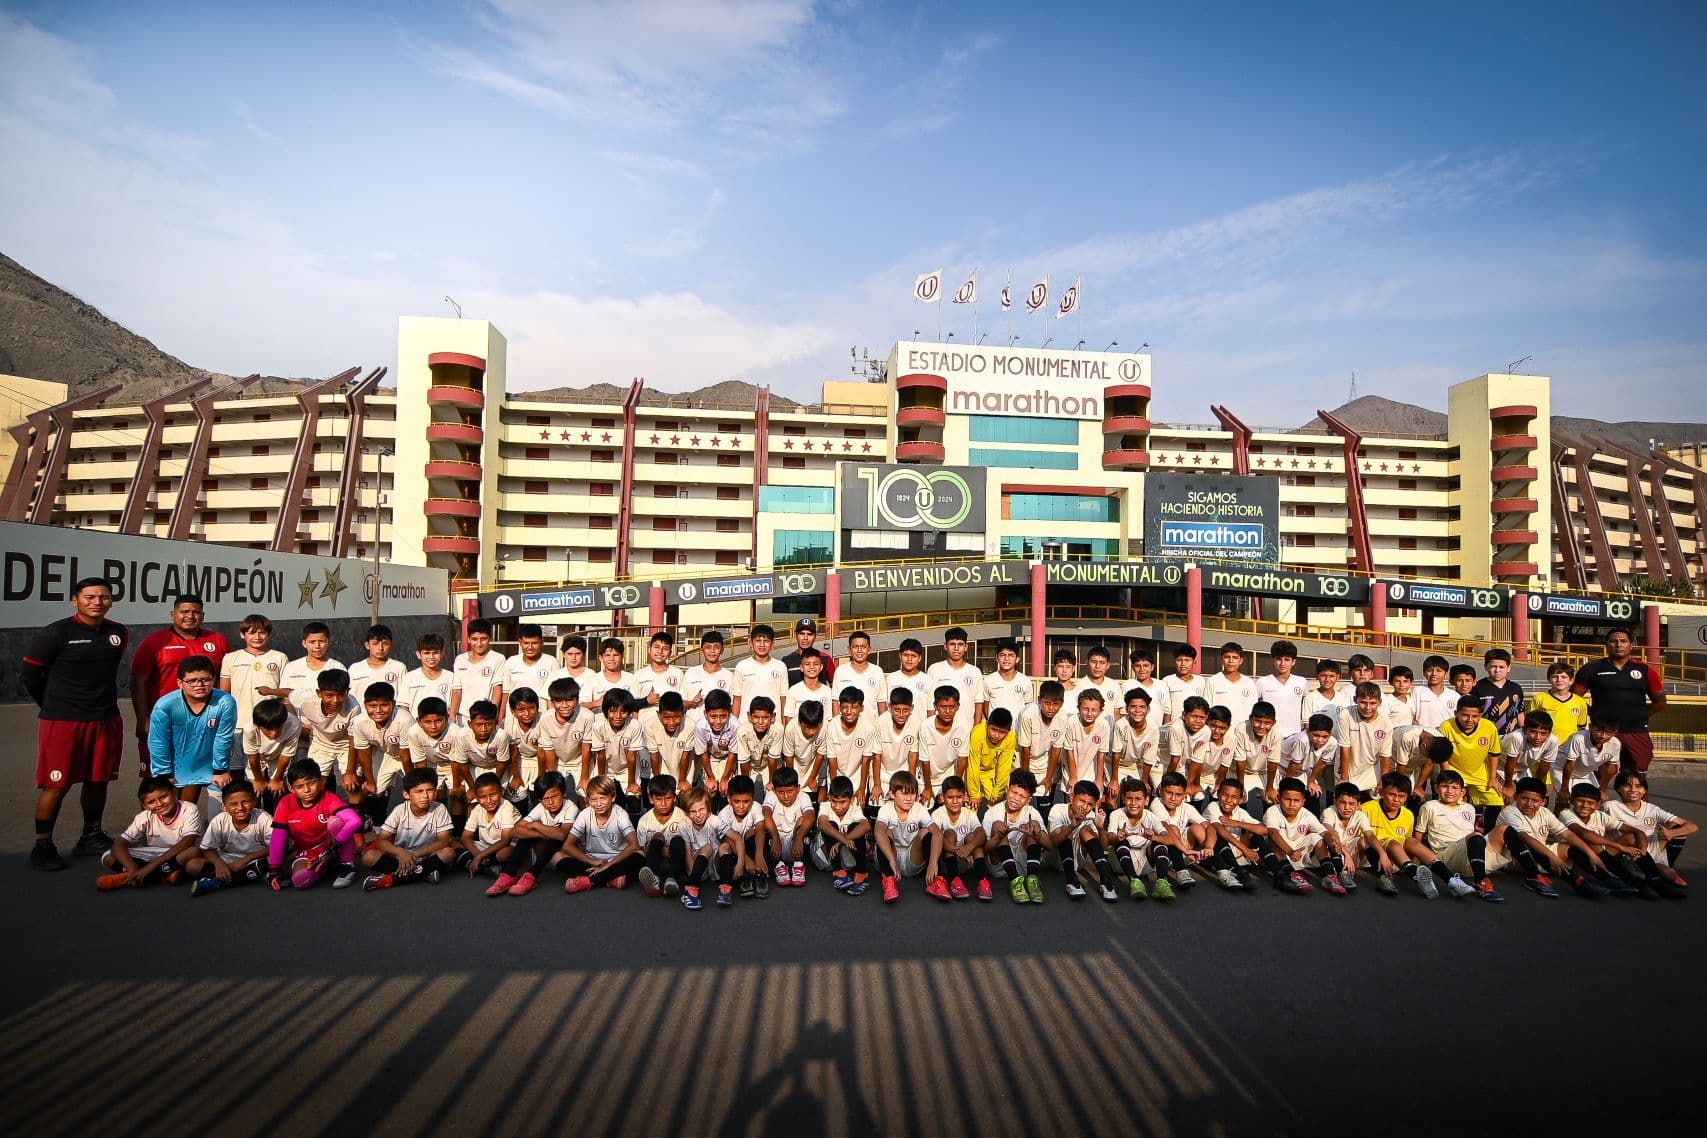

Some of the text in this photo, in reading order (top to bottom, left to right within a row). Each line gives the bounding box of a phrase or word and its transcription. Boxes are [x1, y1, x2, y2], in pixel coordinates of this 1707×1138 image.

[909, 351, 1137, 380] ESTADIO MONUMENTAL U
[953, 390, 1098, 416] marathon
[858, 467, 972, 529] 100
[918, 491, 931, 507] U
[937, 495, 953, 503] 2024
[1188, 491, 1237, 504] SIGAMOS
[1161, 502, 1264, 517] HACIENDO HISTORIA
[1165, 526, 1259, 545] marathon
[103, 557, 284, 604] BICAMPEÓN
[854, 564, 1013, 589] BIENVENIDOS AL
[1047, 563, 1178, 584] MONUMENTAL U
[1211, 571, 1350, 597] marathon 100
[382, 582, 426, 600] marathon
[706, 581, 770, 597] marathon
[779, 573, 817, 595] 100
[524, 594, 592, 610] marathon
[601, 585, 641, 607] 100
[1412, 588, 1464, 603] marathon
[1470, 589, 1500, 609] 100
[1549, 599, 1598, 613] marathon
[1604, 600, 1633, 619] 100
